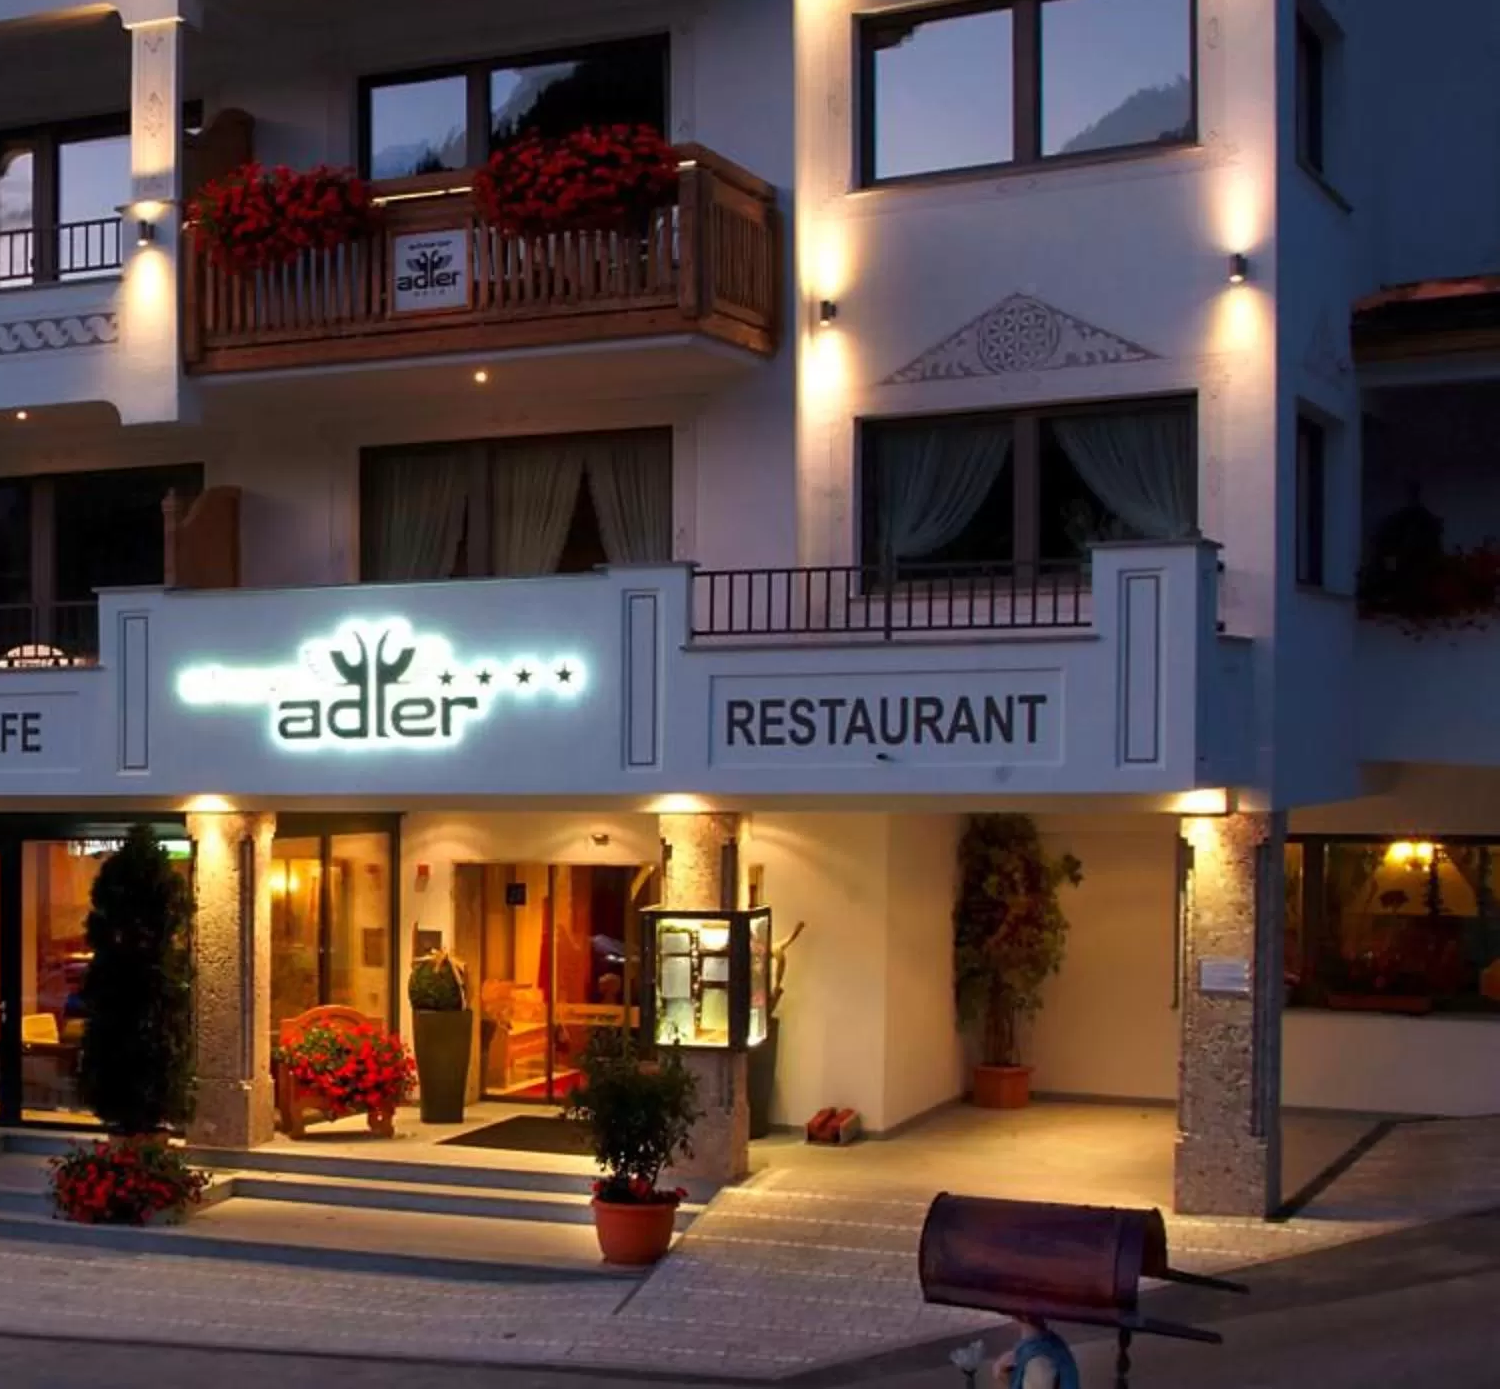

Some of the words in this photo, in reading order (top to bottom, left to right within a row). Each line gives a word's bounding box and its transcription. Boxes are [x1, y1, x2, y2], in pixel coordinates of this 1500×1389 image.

[397, 262, 462, 292] adler
[277, 666, 479, 740] adler
[725, 694, 1048, 746] RESTAURANT
